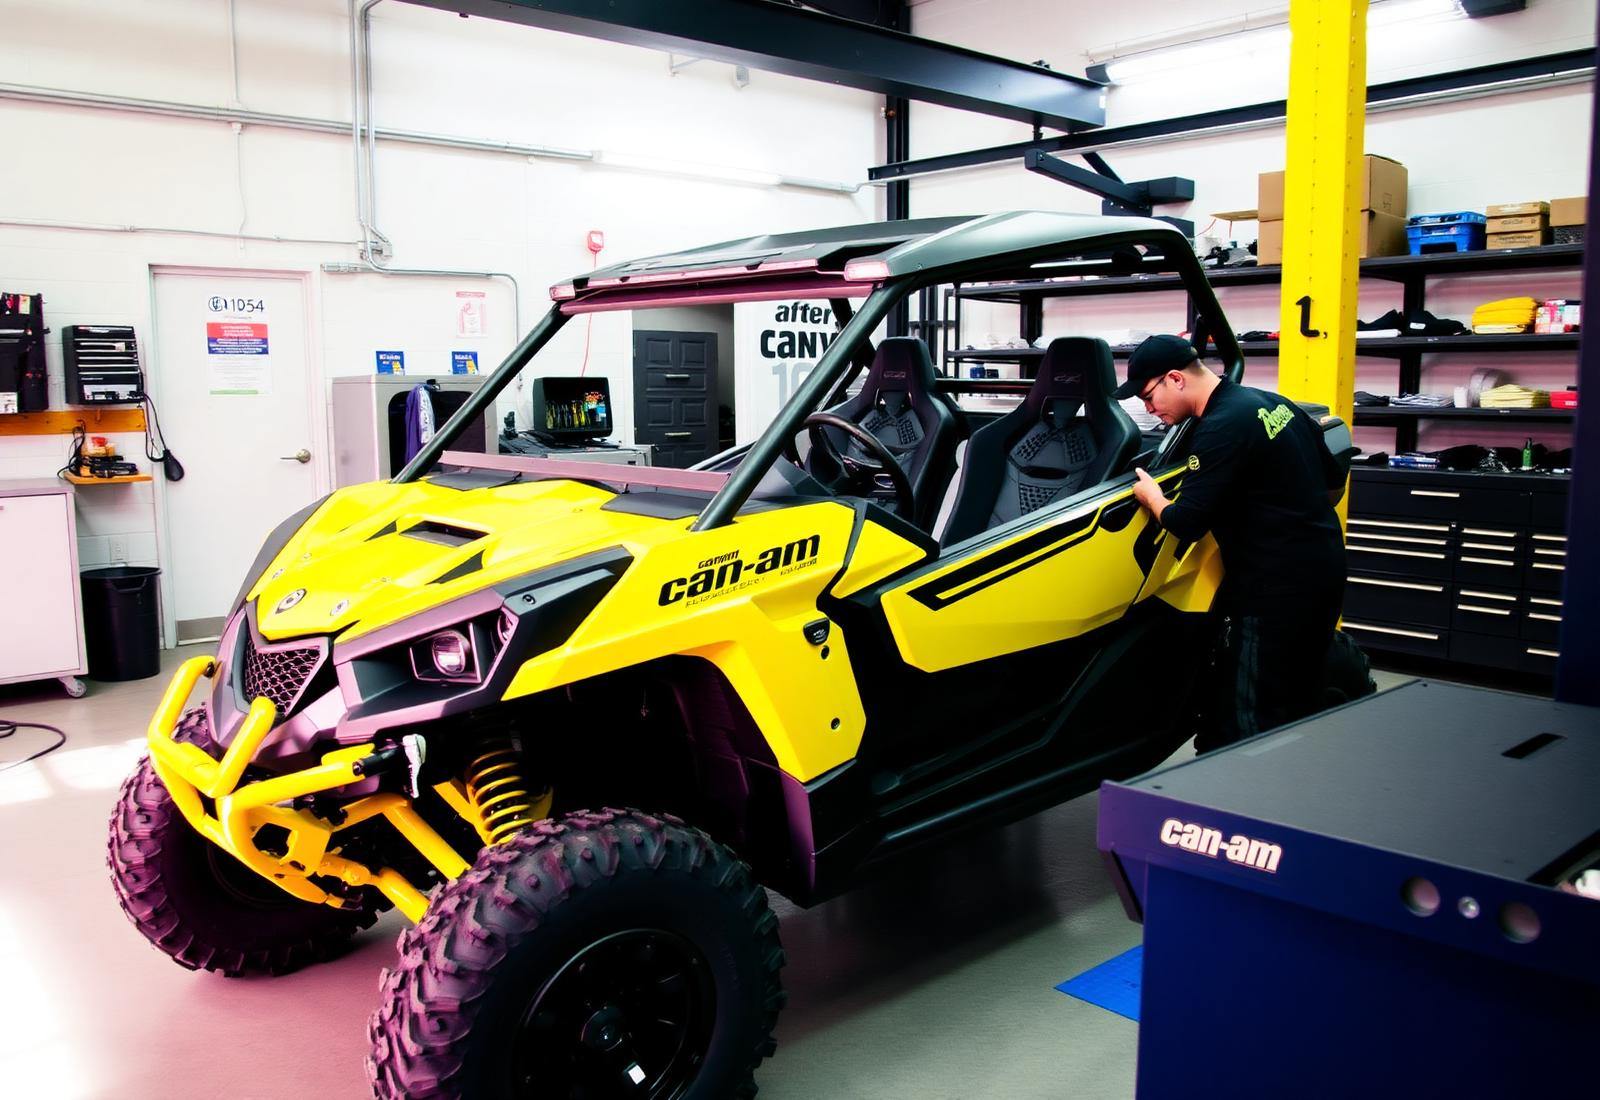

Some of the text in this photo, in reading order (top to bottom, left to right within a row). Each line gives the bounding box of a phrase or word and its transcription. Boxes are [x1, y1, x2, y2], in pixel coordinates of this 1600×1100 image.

[775, 301, 832, 324] after
[658, 534, 821, 607] can-am
[1160, 819, 1282, 873] can-am
